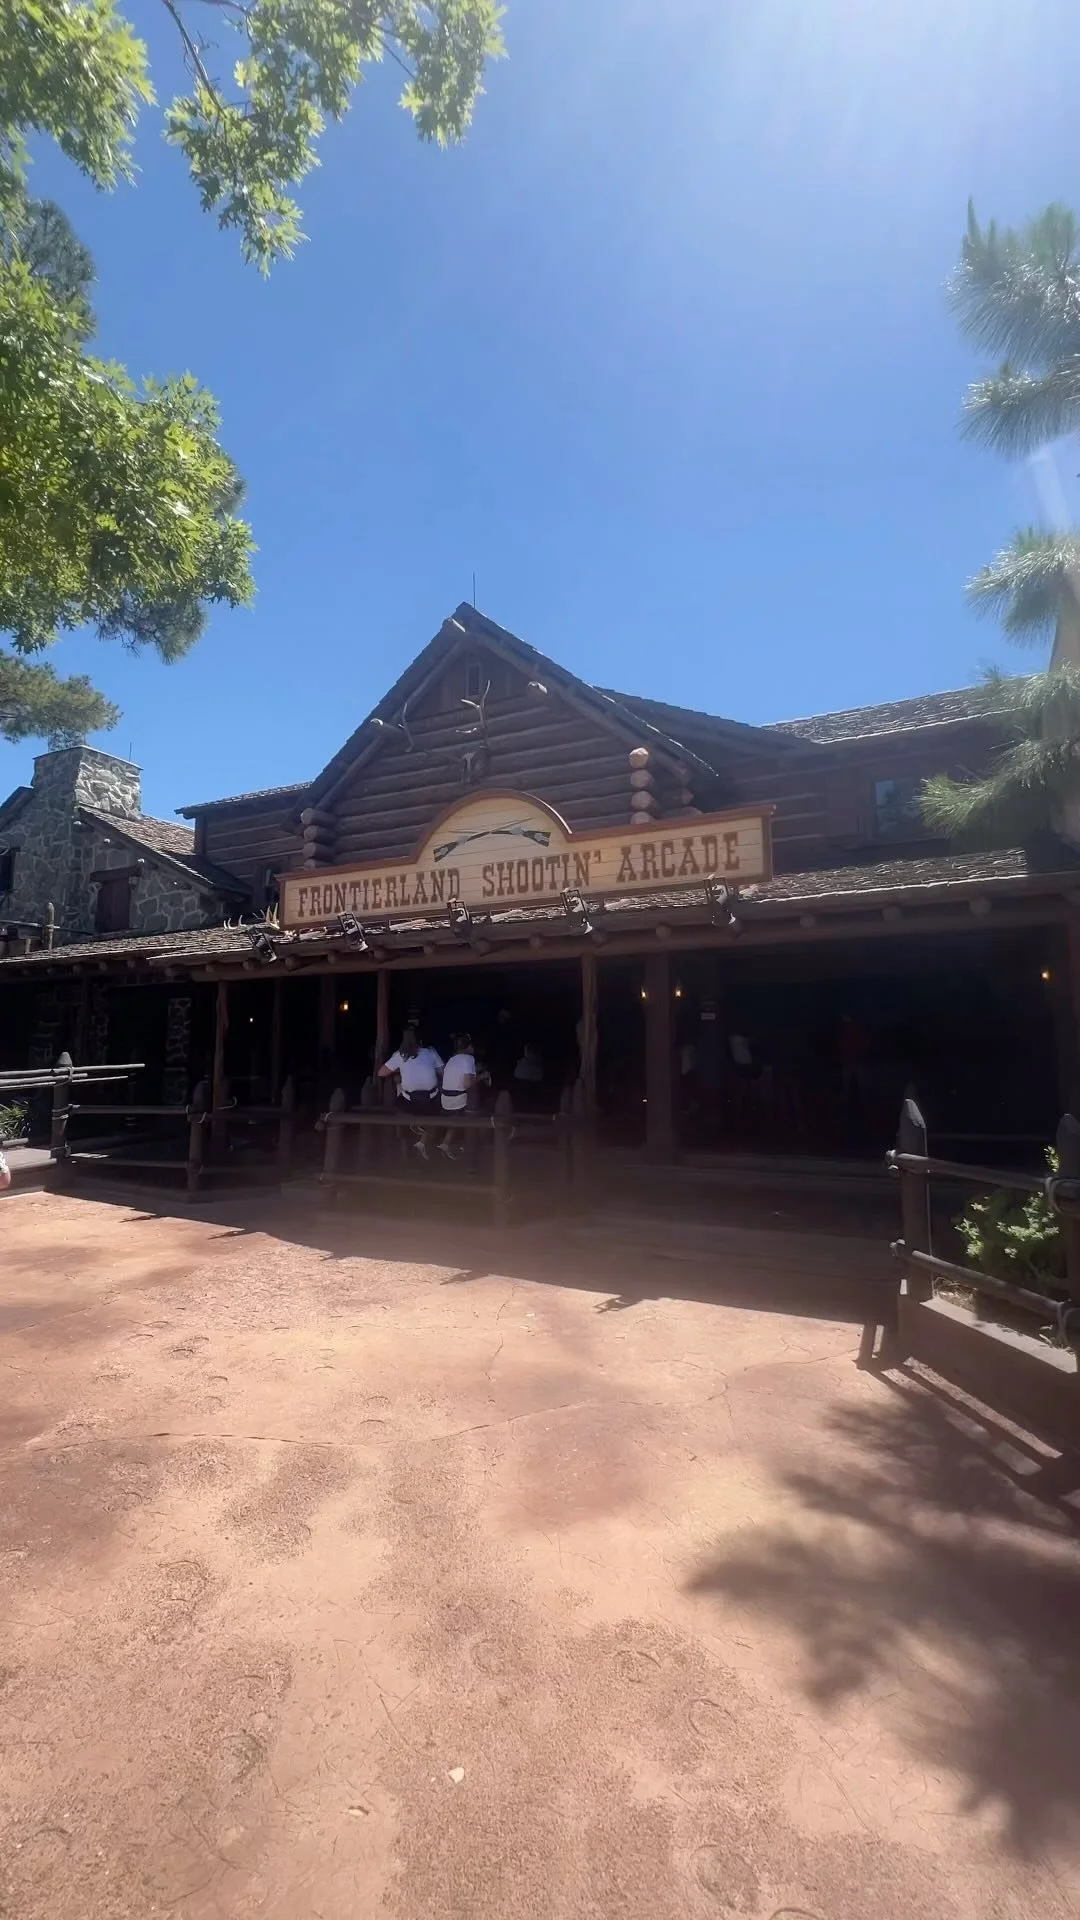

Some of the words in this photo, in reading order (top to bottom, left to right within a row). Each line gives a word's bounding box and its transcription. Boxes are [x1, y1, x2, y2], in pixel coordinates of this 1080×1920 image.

[298, 868, 461, 918] FRONTIERLAND
[482, 851, 601, 897] SHOOTIN'
[616, 832, 741, 883] ARCADE
